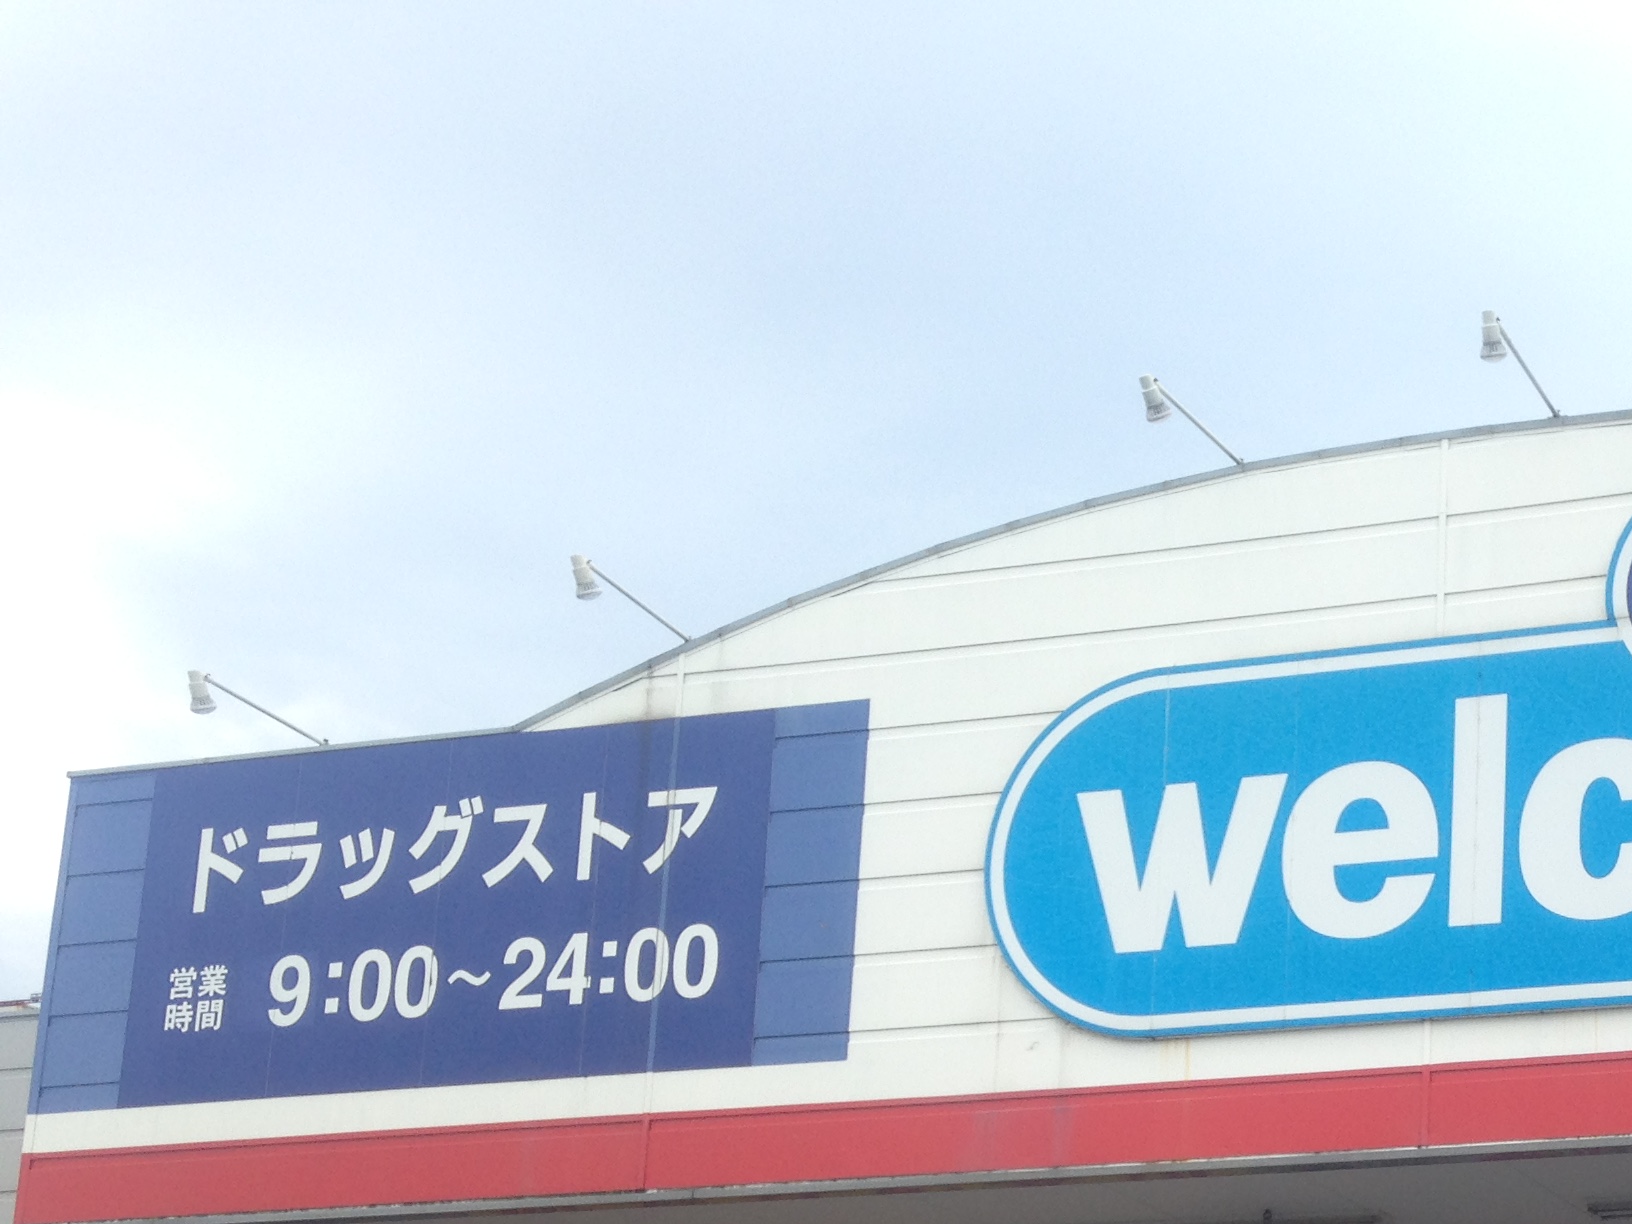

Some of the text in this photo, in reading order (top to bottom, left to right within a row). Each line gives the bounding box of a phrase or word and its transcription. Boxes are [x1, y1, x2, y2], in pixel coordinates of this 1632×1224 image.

[192, 785, 719, 914] ドラッグストア
[168, 964, 229, 998] 営業
[163, 1000, 224, 1033] 時間
